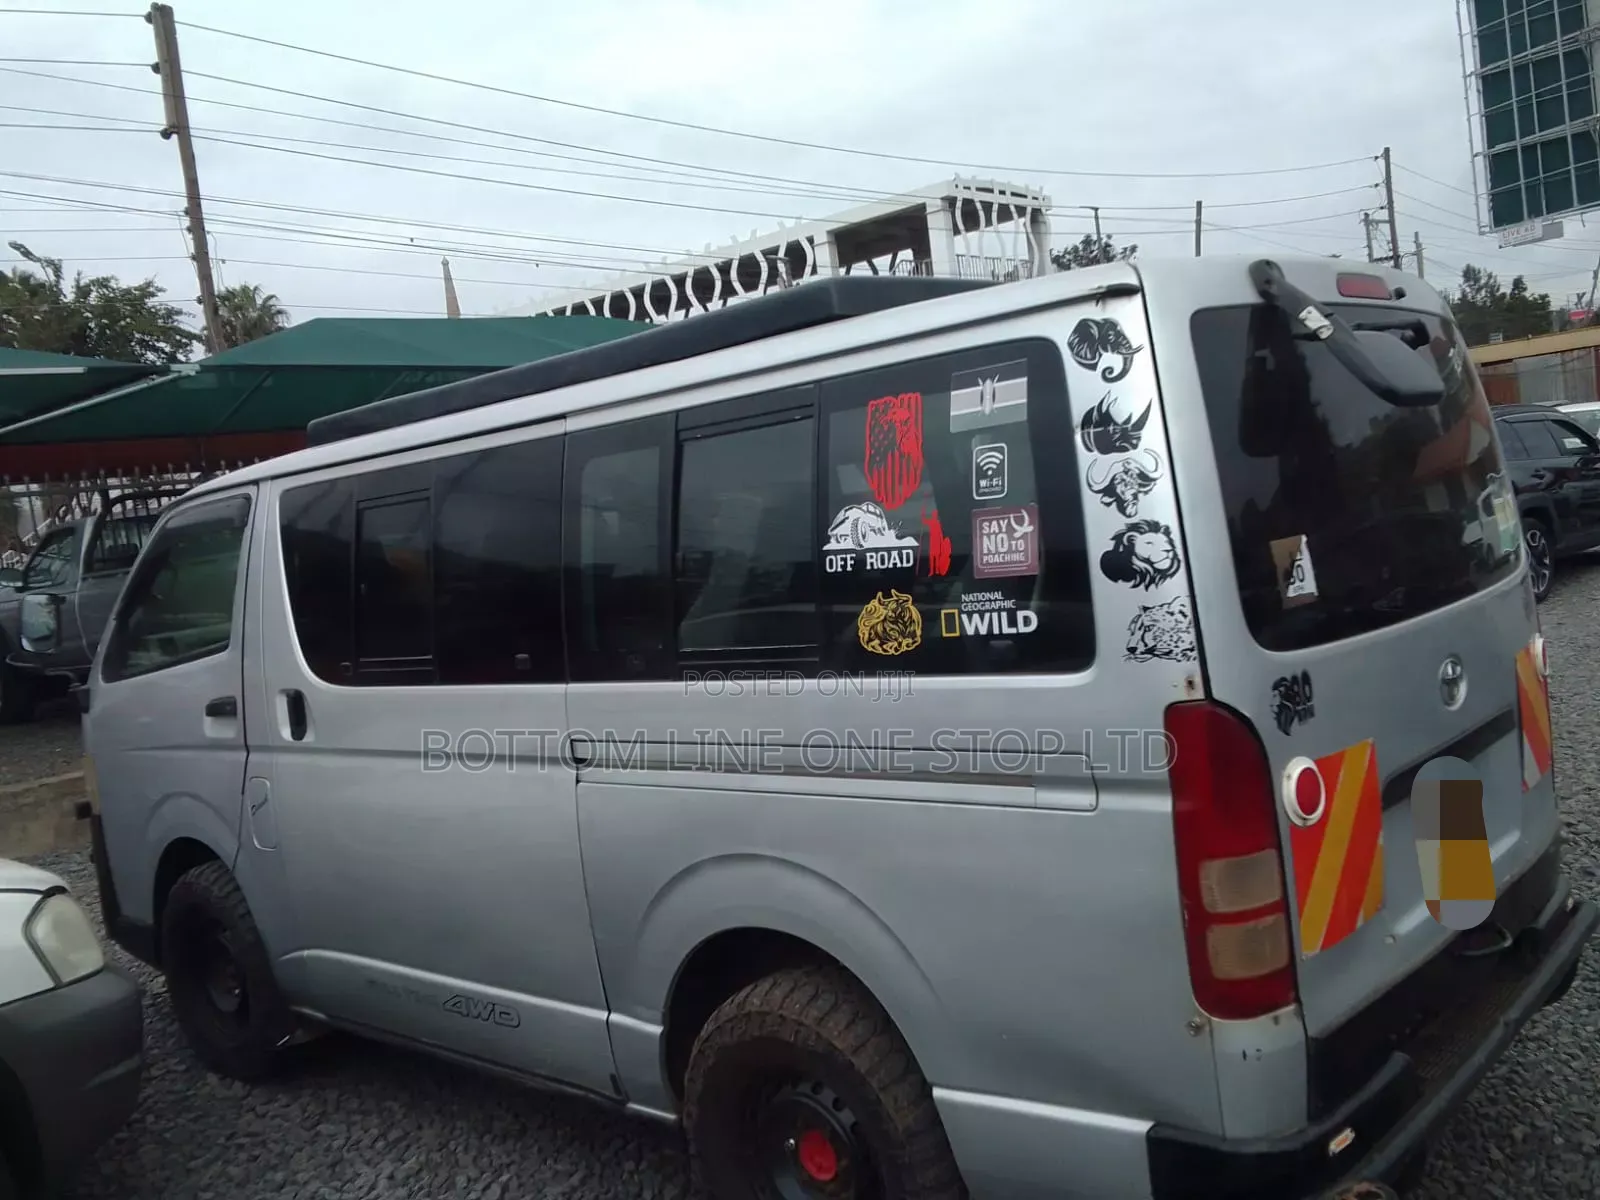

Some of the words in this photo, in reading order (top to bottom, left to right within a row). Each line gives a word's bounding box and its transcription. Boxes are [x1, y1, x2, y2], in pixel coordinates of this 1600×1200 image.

[979, 477, 1002, 488] Wi-Fi
[982, 519, 1008, 534] SAY
[983, 533, 1009, 554] NO
[1011, 539, 1025, 551] TO
[825, 553, 856, 573] OFF
[866, 550, 914, 569] ROAD
[983, 552, 1025, 564] POACHING
[961, 592, 1004, 602] NATIONAL
[961, 600, 1016, 611] GEOGRAPHIC
[961, 610, 1038, 635] WILD
[442, 994, 521, 1029] 4WD
